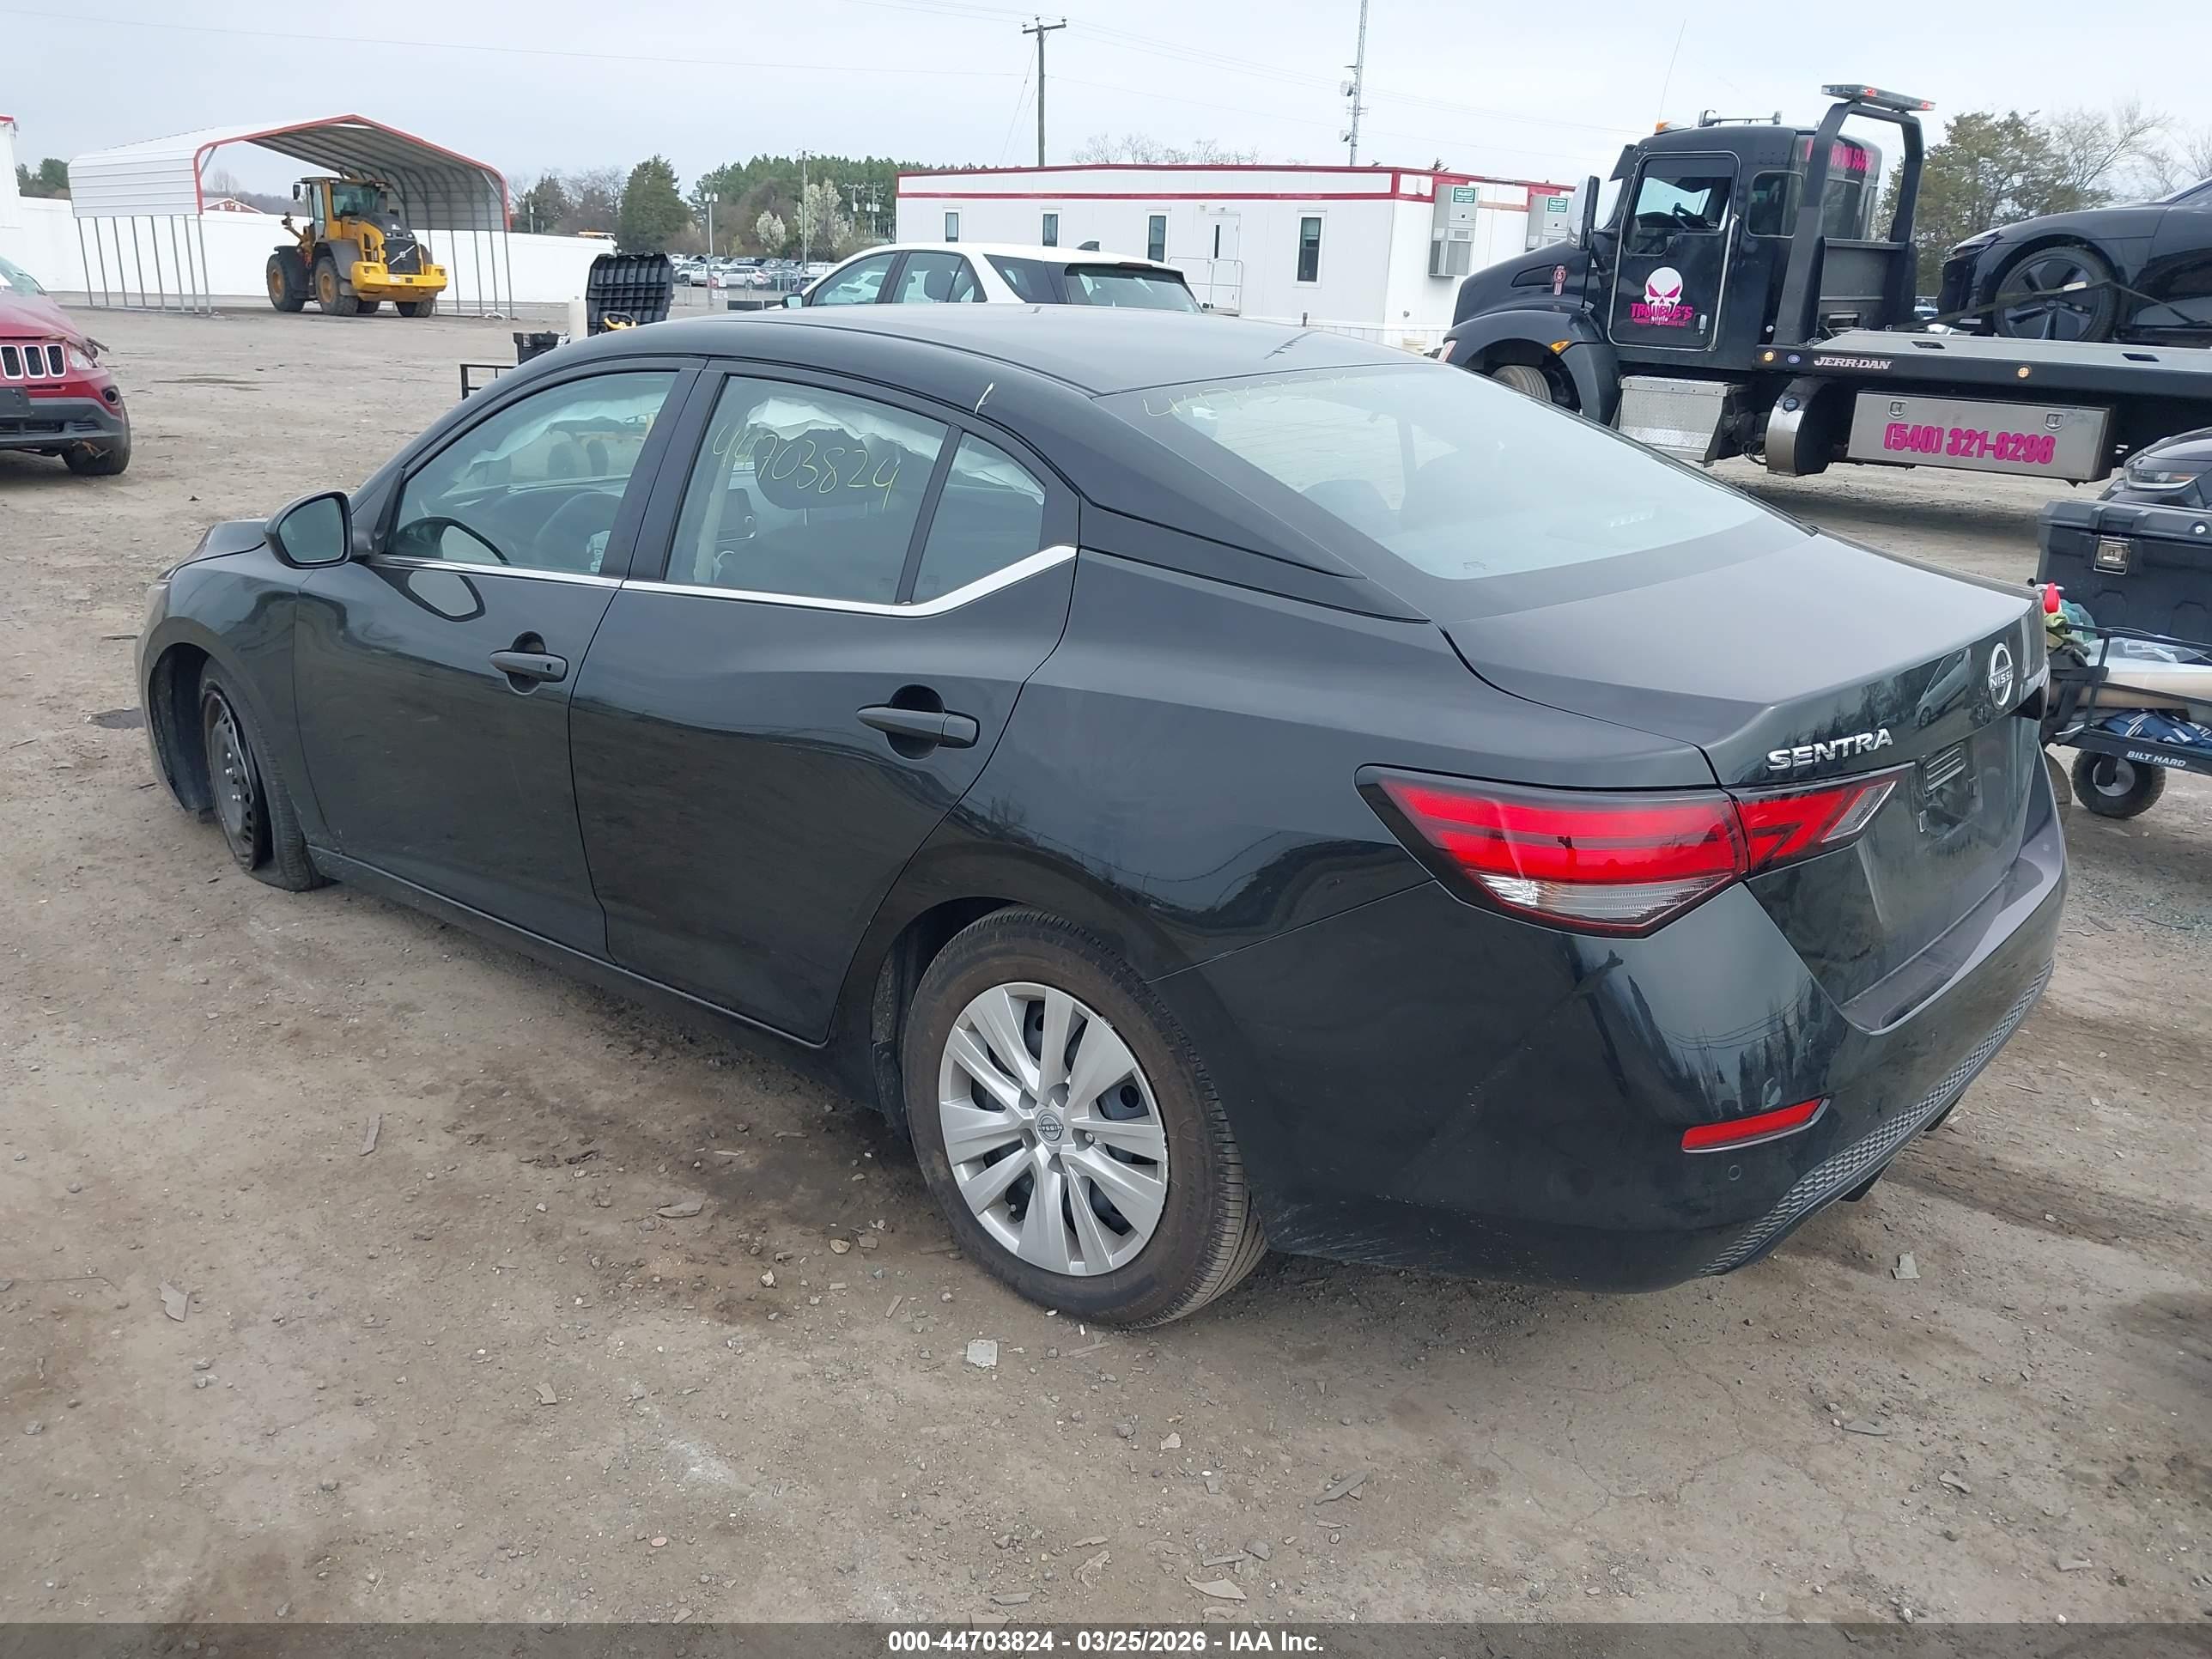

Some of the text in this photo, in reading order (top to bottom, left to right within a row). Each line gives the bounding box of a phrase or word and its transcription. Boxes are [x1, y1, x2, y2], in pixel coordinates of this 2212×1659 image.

[1884, 422, 2057, 465] (540) 321-8298
[713, 425, 901, 509] 44703824
[1765, 727, 1893, 771] SENTRA
[2126, 750, 2186, 768] BILT HARD
